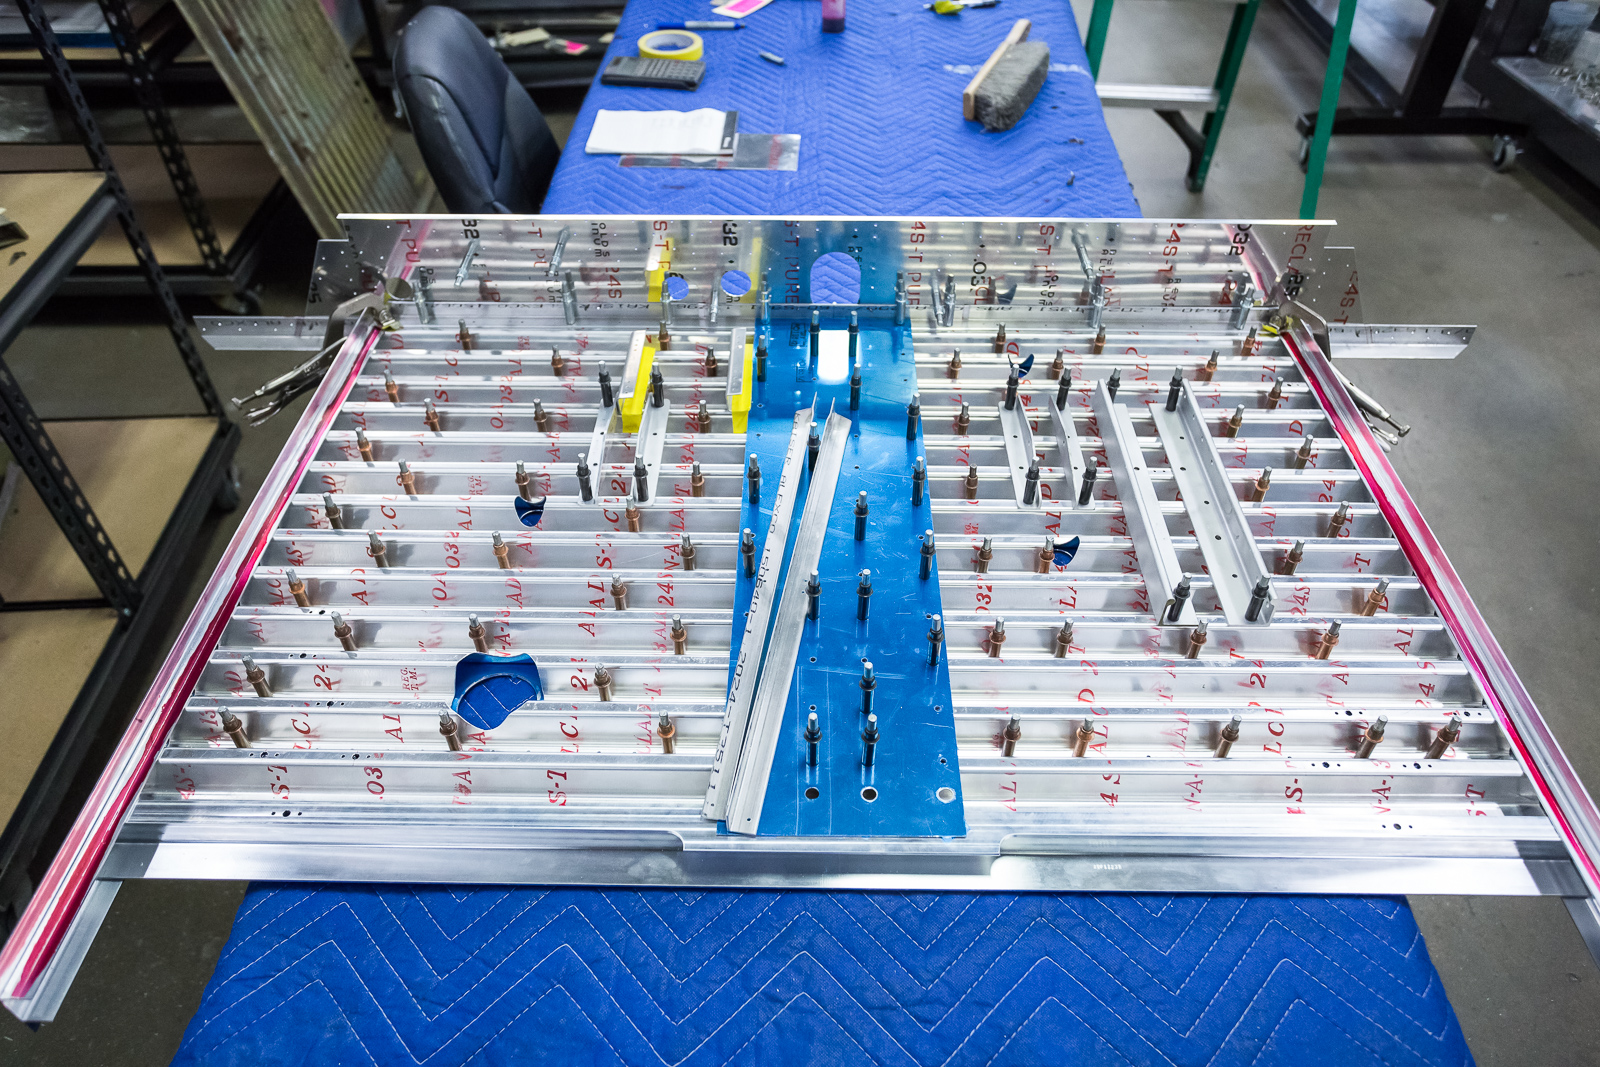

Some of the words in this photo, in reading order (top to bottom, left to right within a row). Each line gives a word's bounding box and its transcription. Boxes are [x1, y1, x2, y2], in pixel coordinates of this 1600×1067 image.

[653, 220, 669, 250] S-T
[722, 220, 739, 246] 32
[784, 413, 801, 466] KAISER
[708, 651, 747, 790] 2024-T3511
